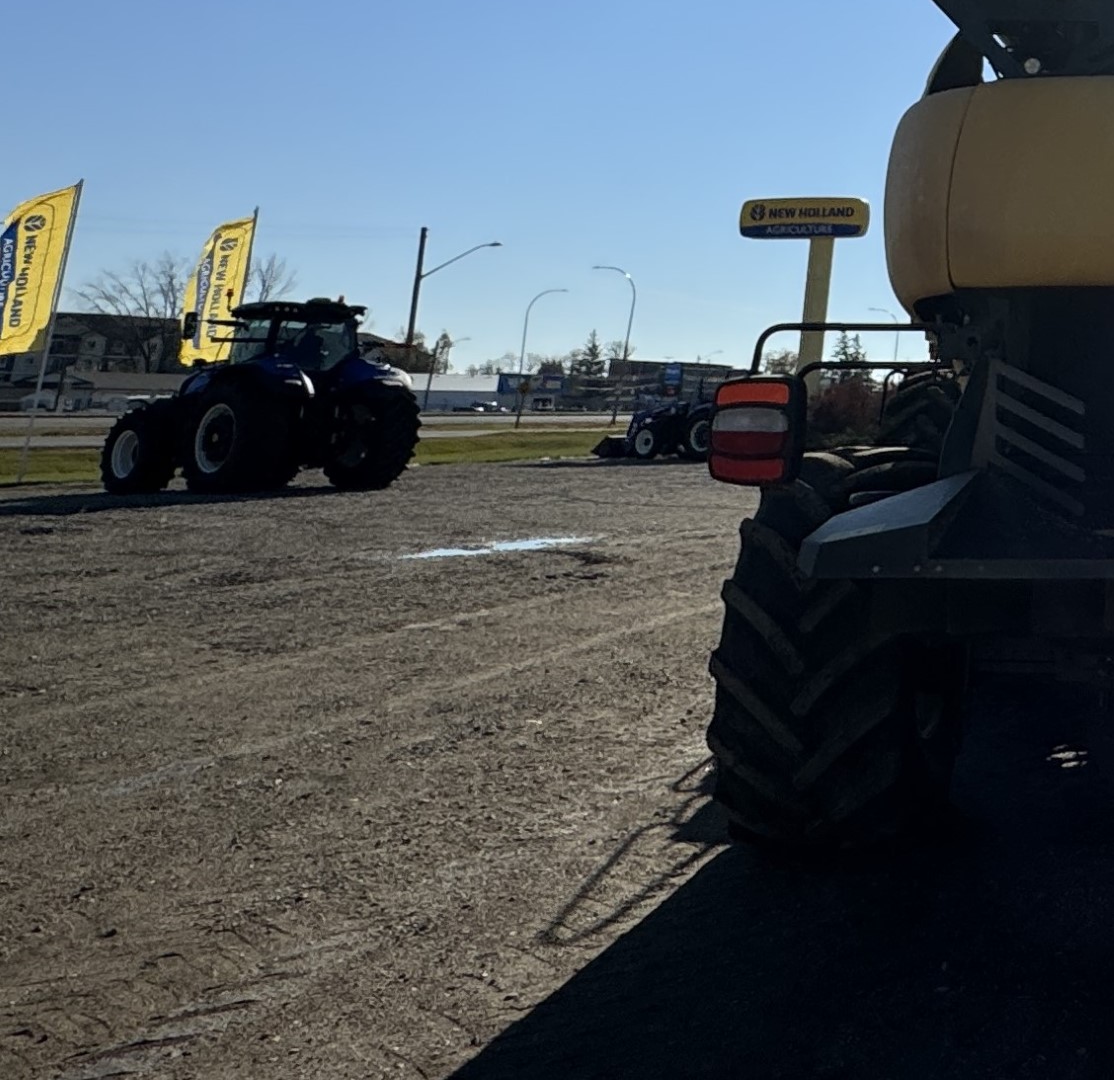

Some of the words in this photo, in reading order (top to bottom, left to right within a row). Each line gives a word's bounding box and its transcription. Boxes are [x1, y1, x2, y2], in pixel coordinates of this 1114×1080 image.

[768, 207, 796, 218] NEW
[798, 206, 854, 218] HOLLAND
[766, 224, 833, 234] AGRICULTURE
[23, 235, 38, 264] NEW
[215, 255, 230, 281] NEW
[9, 266, 30, 327] HOLLAND
